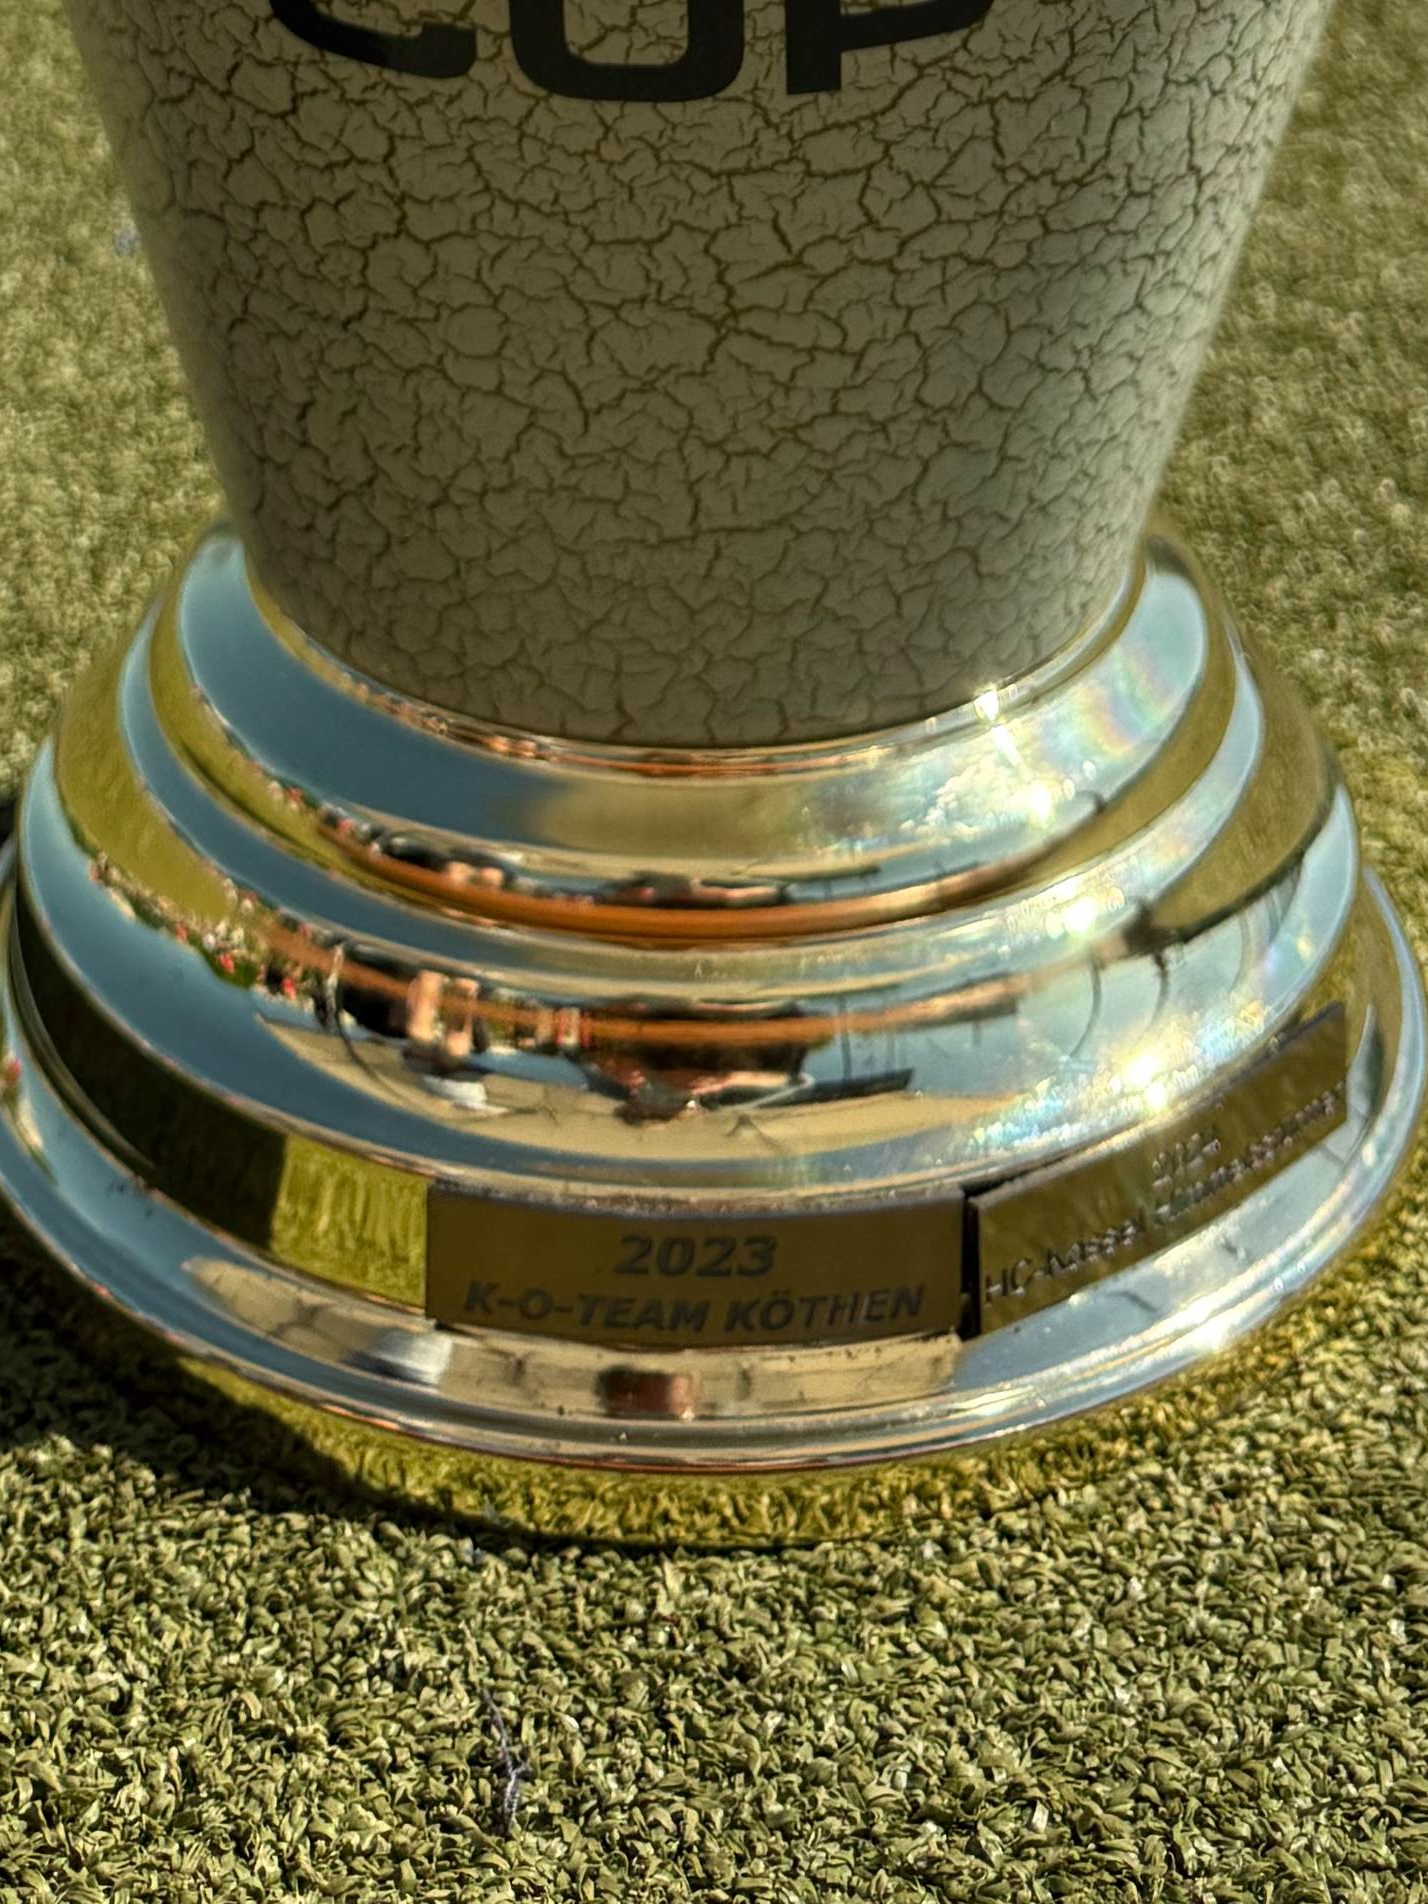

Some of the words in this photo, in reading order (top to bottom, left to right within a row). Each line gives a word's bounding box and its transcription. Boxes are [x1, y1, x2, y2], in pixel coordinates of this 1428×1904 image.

[613, 1234, 779, 1277] 2023
[463, 1279, 710, 1333] K-O-TEAM
[723, 1285, 926, 1333] KÖTHEN
